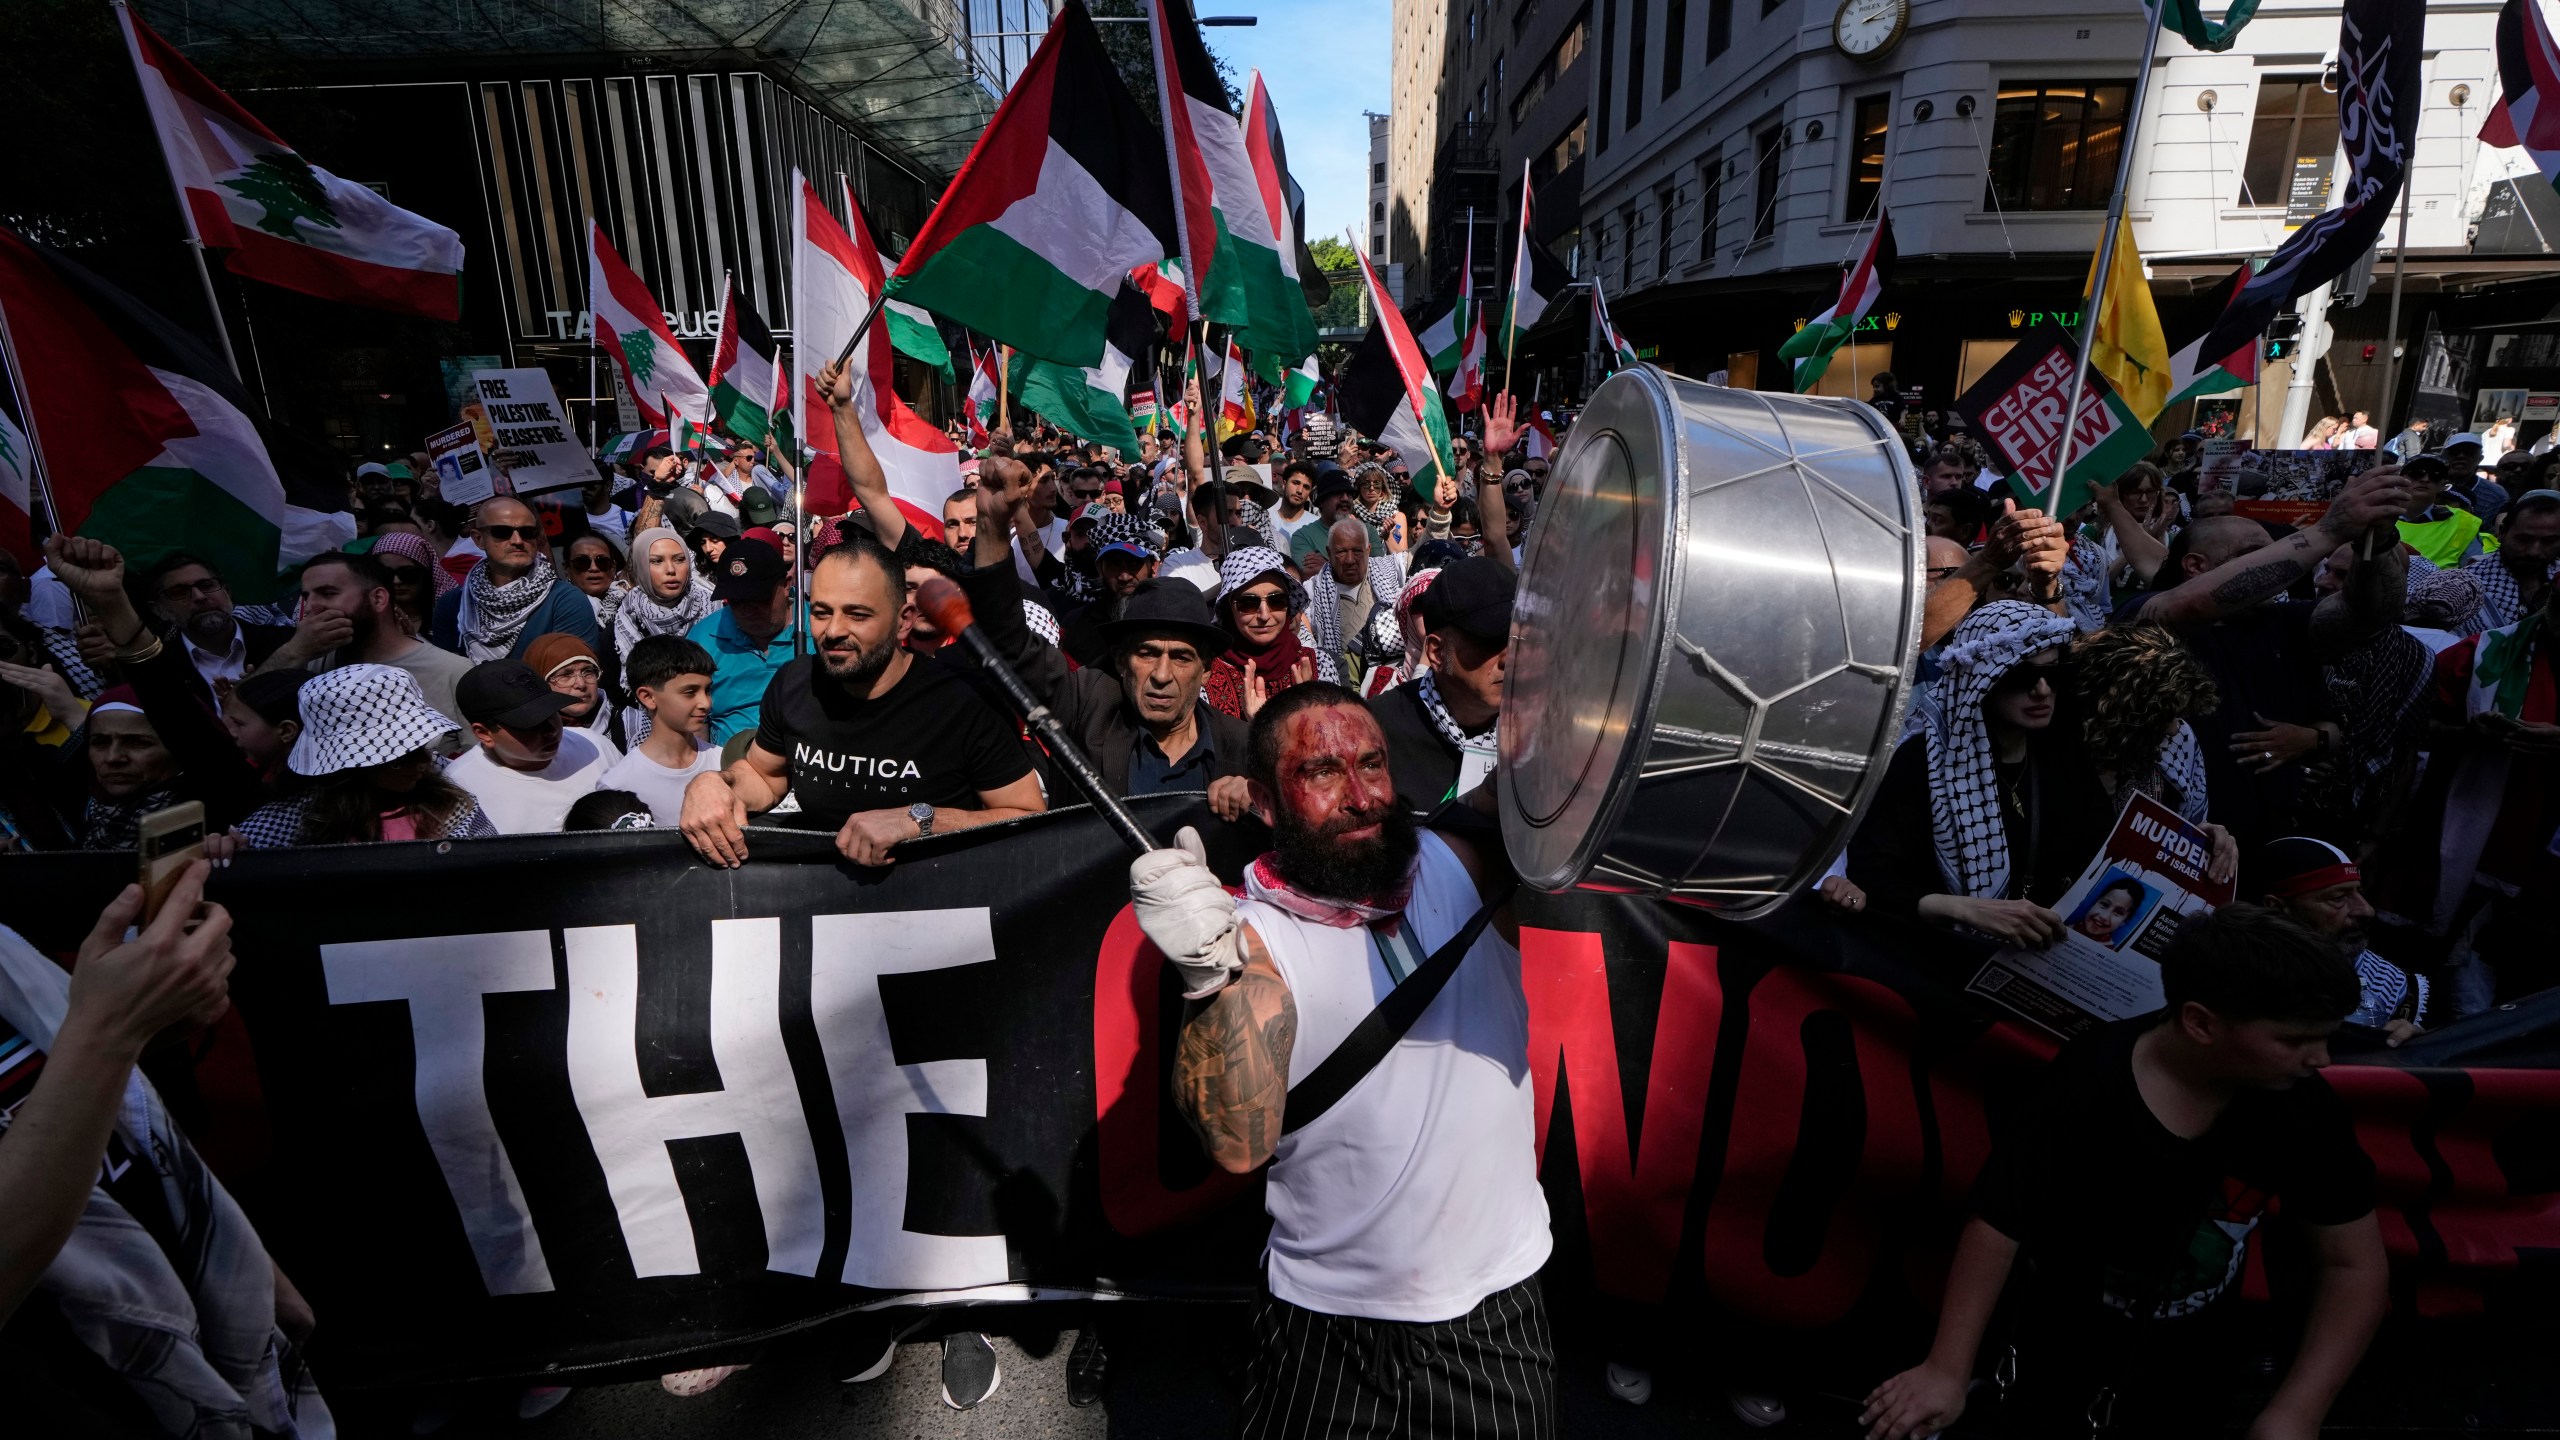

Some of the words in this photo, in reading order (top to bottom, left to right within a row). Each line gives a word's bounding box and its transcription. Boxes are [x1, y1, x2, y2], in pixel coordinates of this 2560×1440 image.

[1859, 3, 1881, 12] ROLEX
[546, 310, 591, 340] TA
[479, 379, 511, 399] FREE
[1985, 351, 2071, 432] CEASE
[488, 403, 560, 423] PALESTINE,
[1134, 404, 1155, 412] WRONG
[1998, 371, 2097, 466] FIRE
[430, 427, 471, 449] MURDERED
[497, 426, 567, 447] CEASEFIRE
[795, 743, 922, 778] NAUTICA
[800, 771, 909, 793] SAILING
[2129, 811, 2212, 872] MURDER
[2155, 850, 2171, 864] BY
[2169, 858, 2200, 882] ISRAEL
[2153, 921, 2174, 936] Mahm
[2159, 914, 2179, 928] Asma
[321, 907, 1013, 1296] THE
